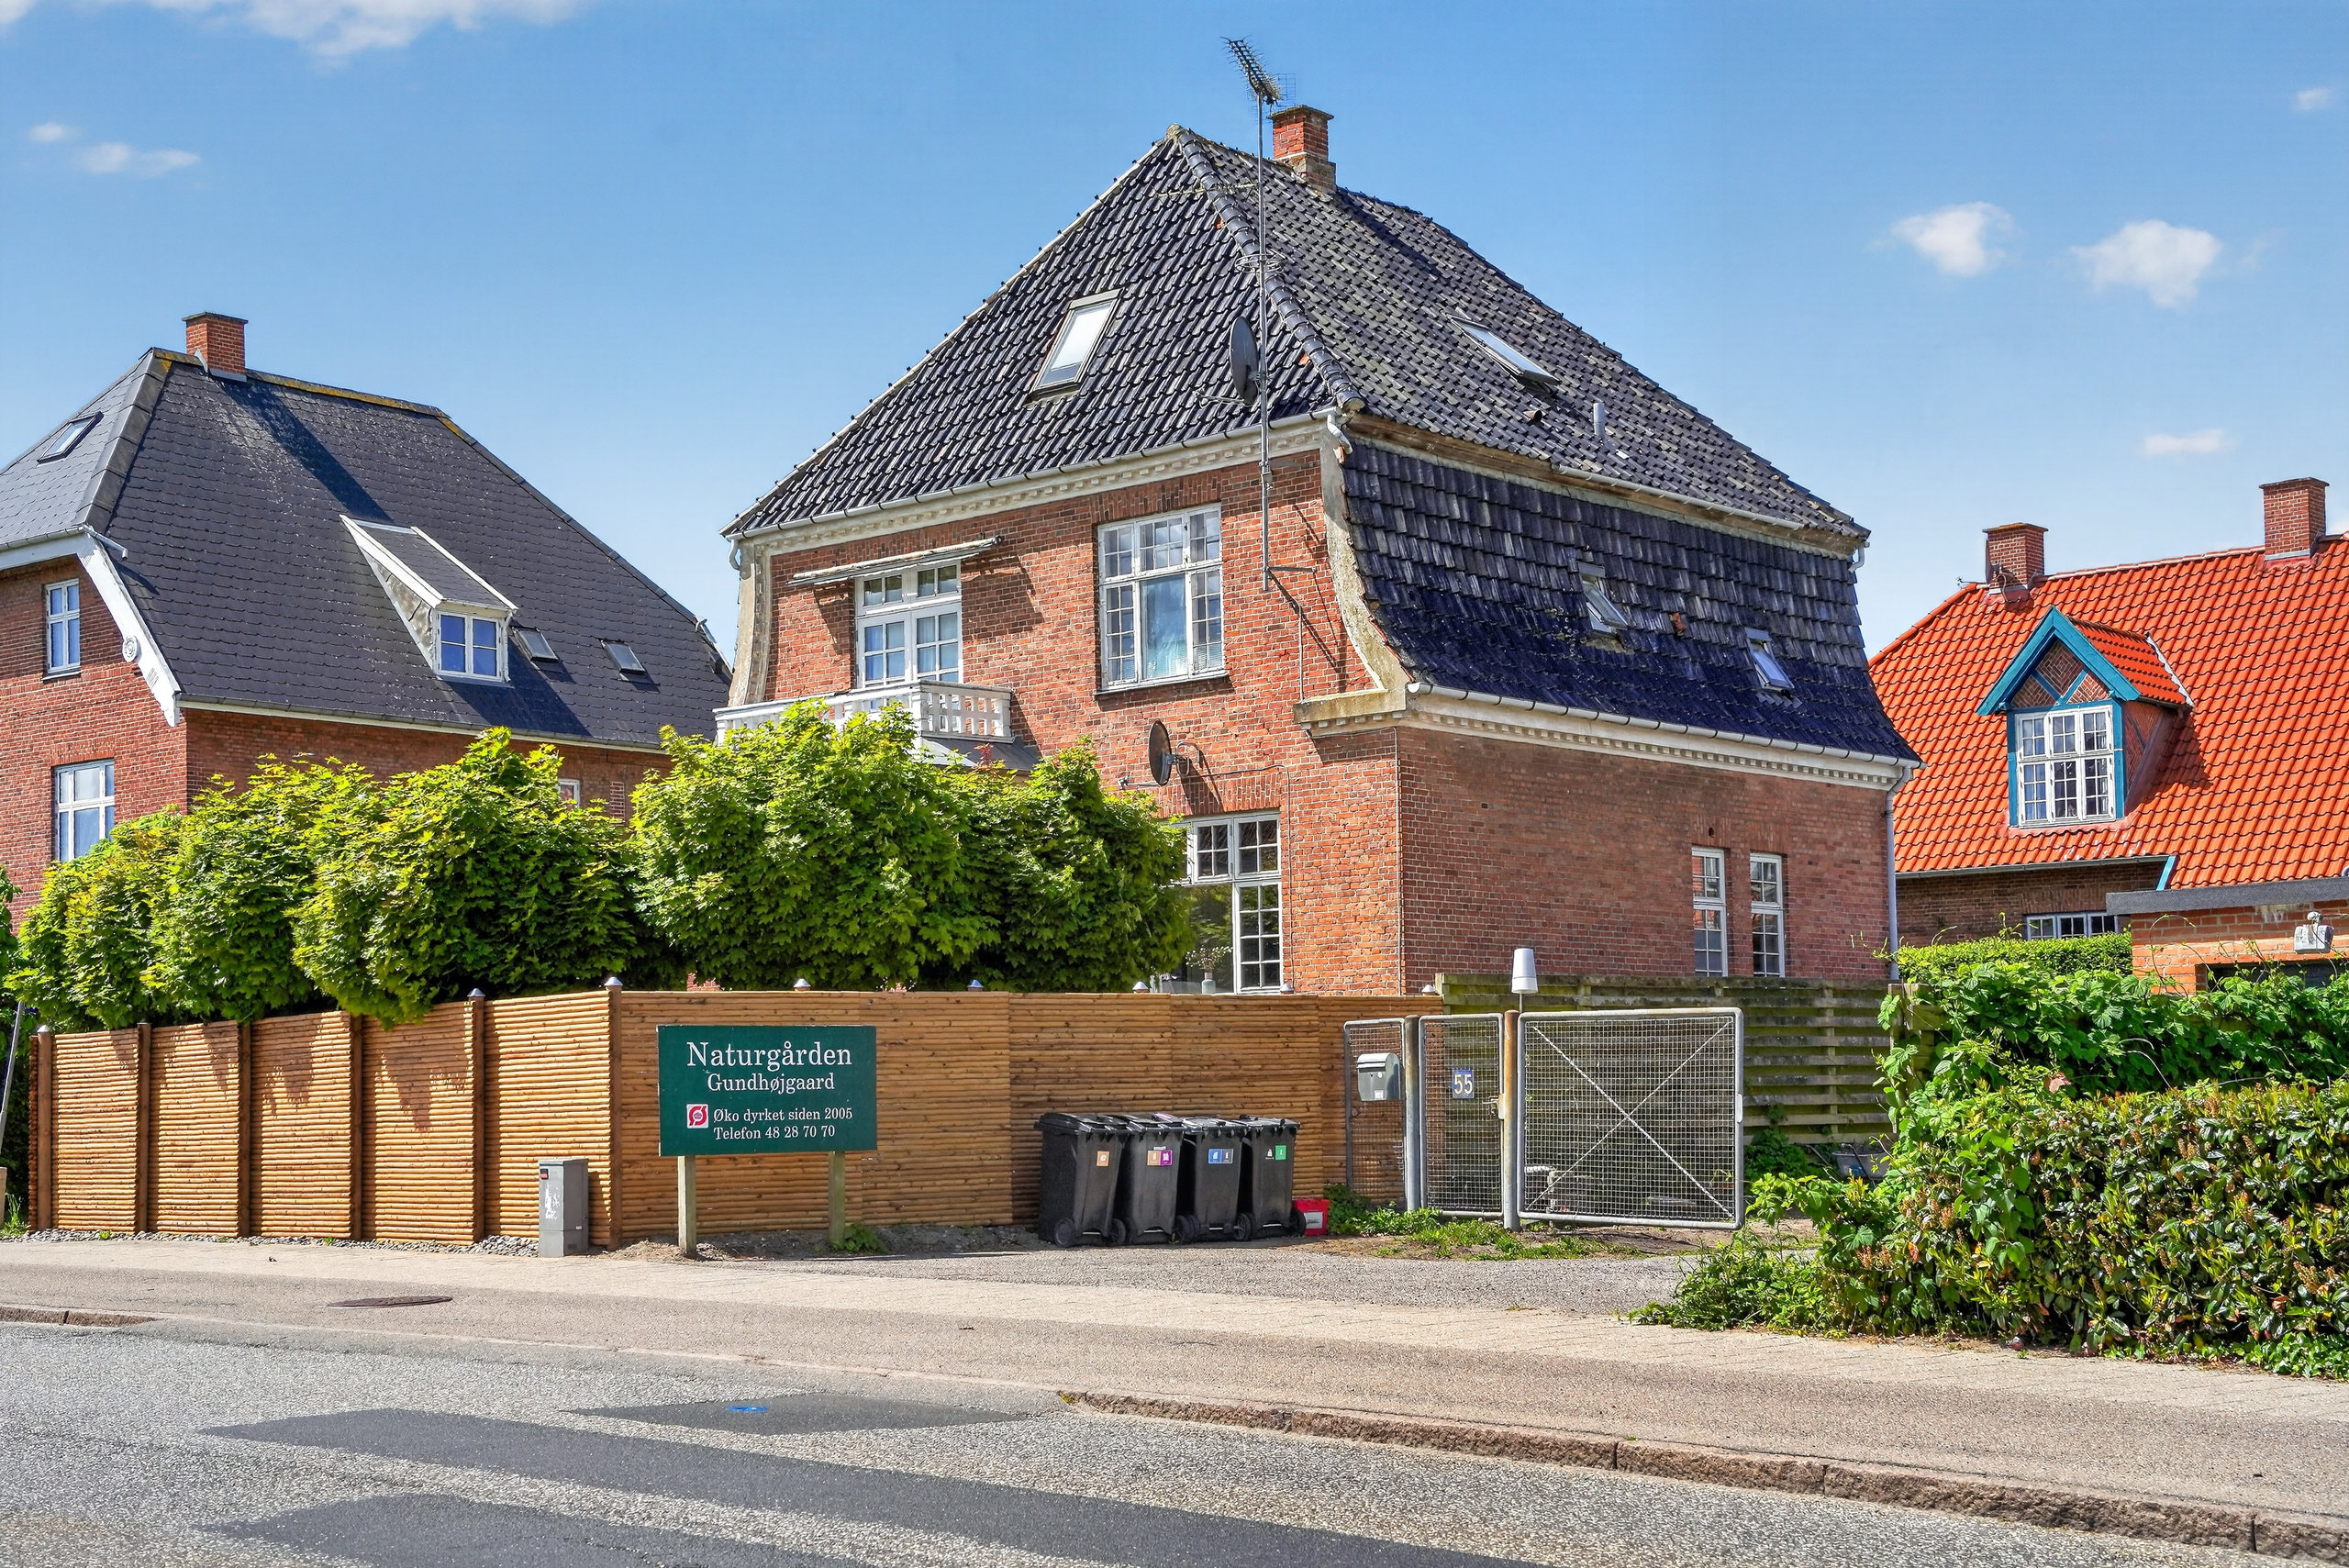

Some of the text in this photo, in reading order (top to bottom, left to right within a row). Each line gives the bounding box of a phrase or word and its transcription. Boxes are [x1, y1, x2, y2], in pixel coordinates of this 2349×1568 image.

[686, 1040, 852, 1072] Naturgården
[707, 1073, 835, 1095] Gundhøjgaard
[1454, 1074, 1473, 1094] 55
[713, 1107, 853, 1124] Øko dyrket siden 2005
[713, 1125, 835, 1140] Telefon 48 28 70 70
